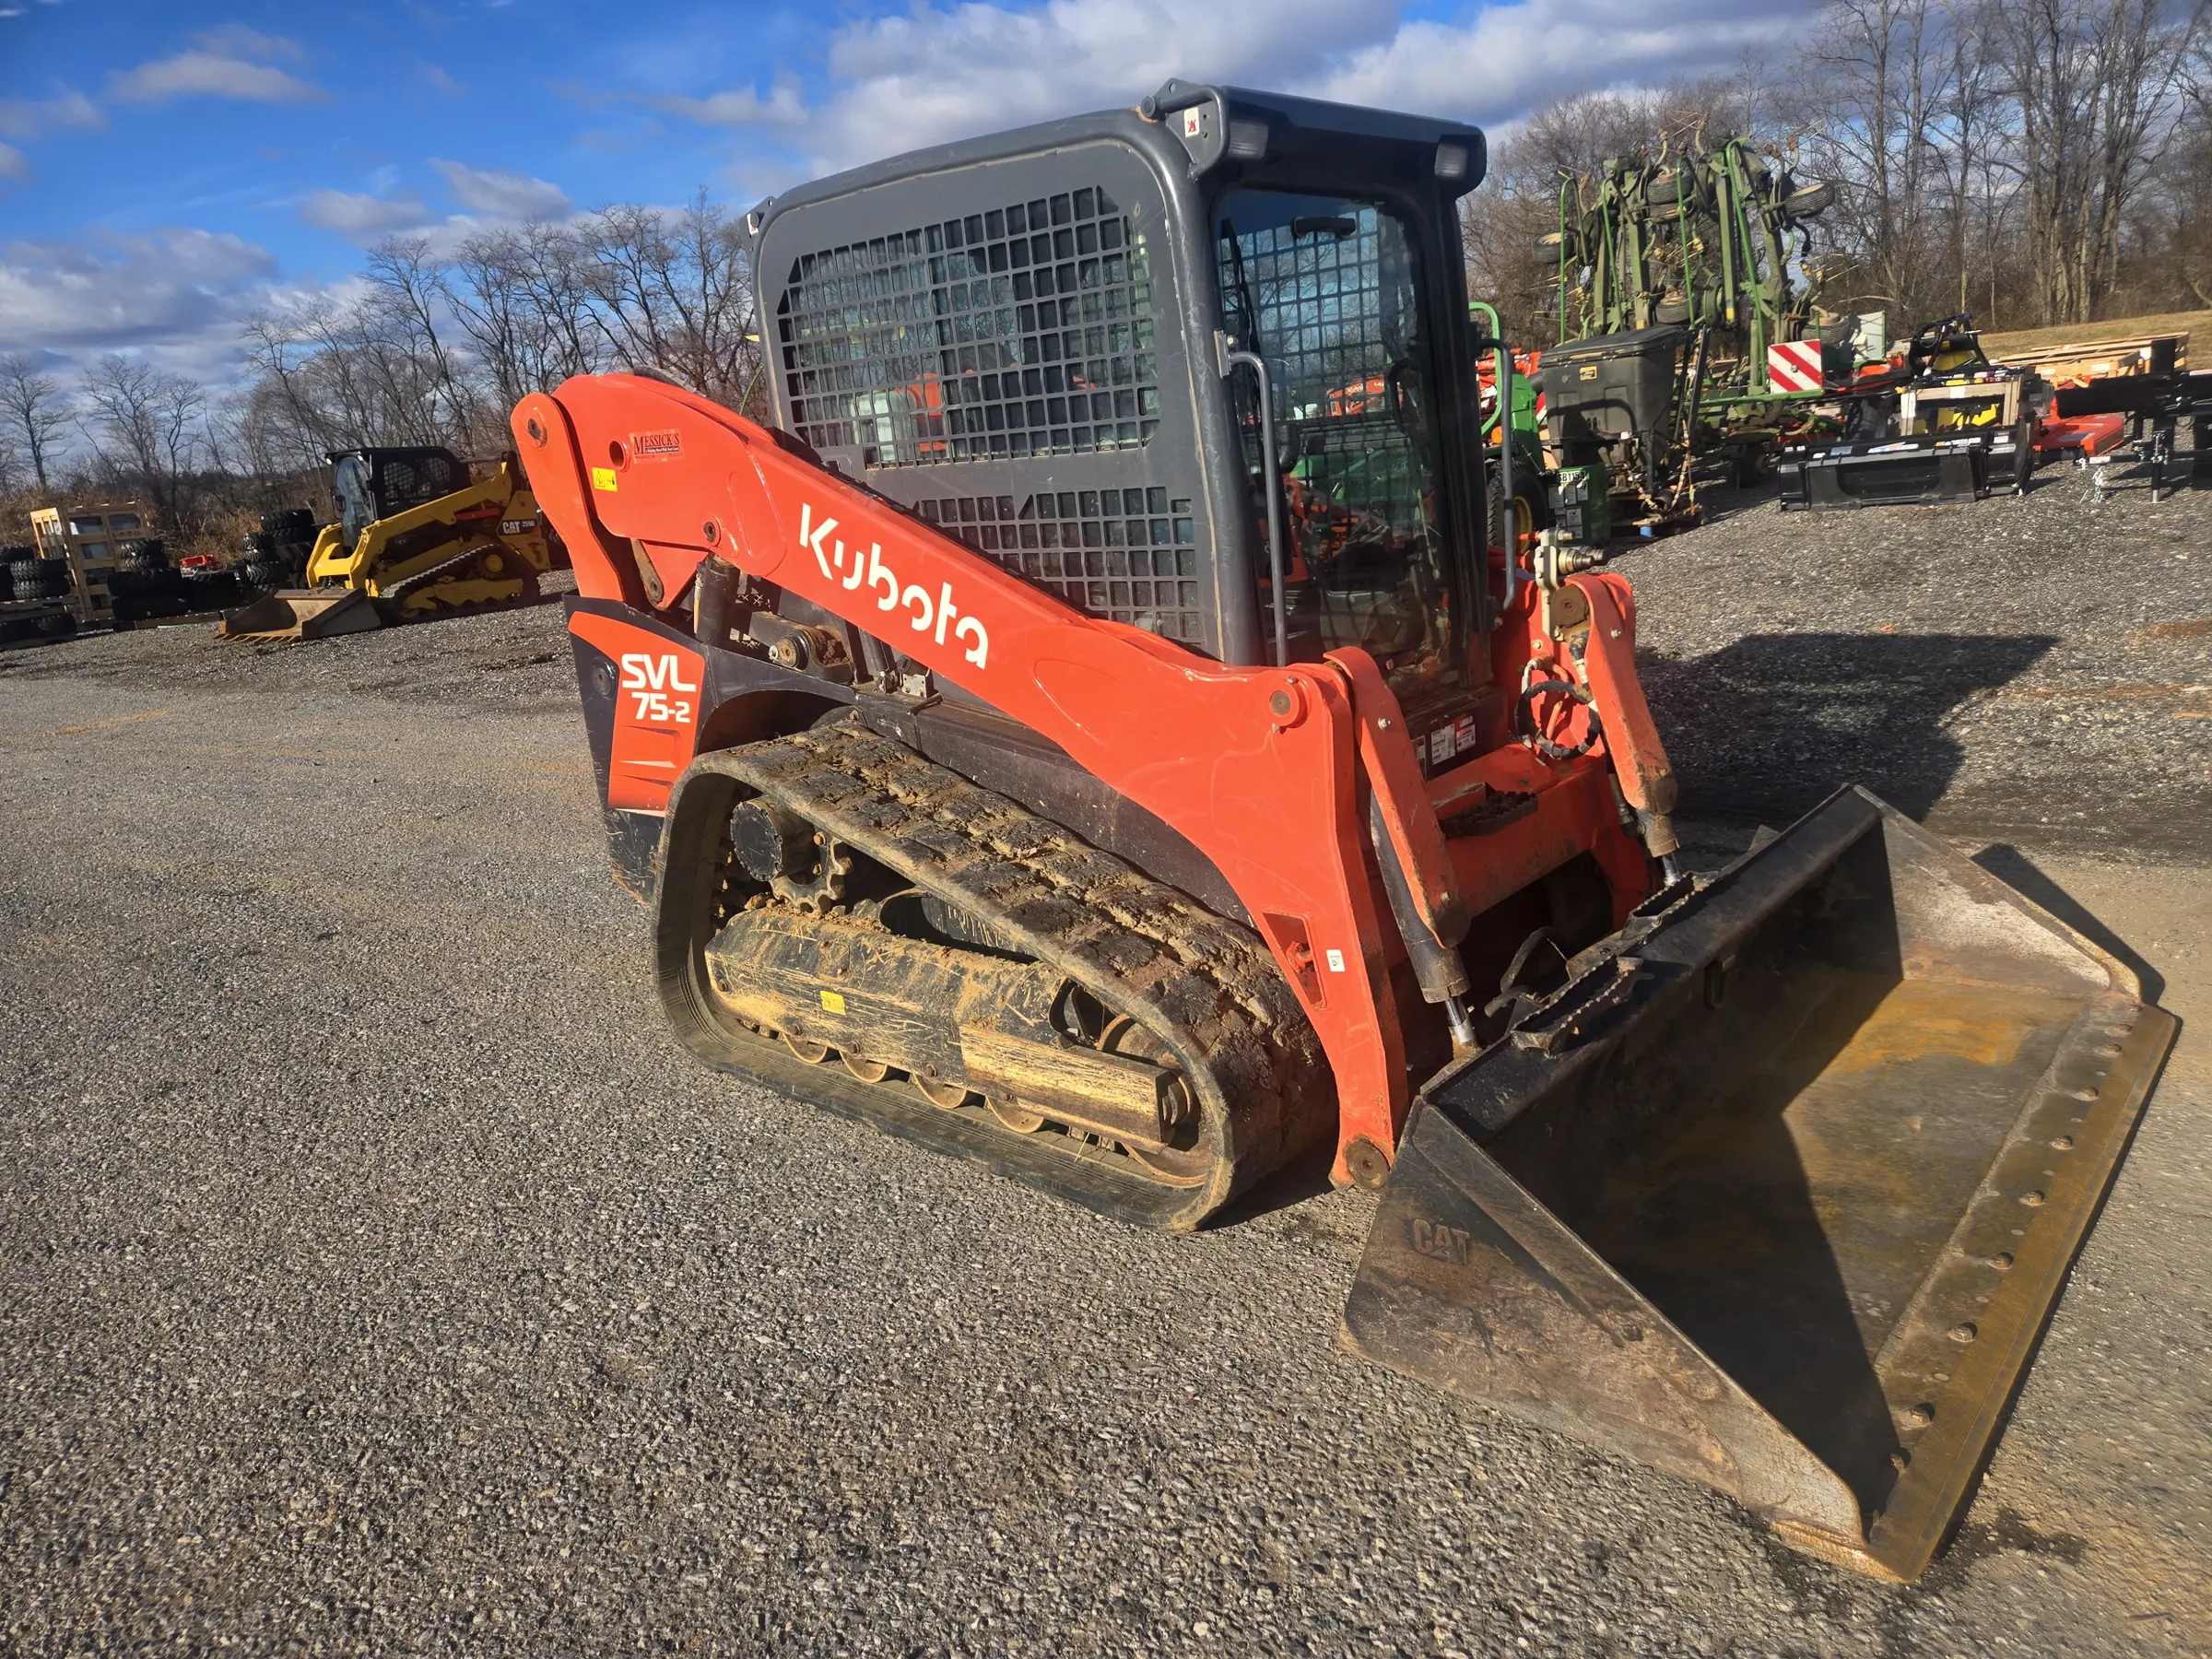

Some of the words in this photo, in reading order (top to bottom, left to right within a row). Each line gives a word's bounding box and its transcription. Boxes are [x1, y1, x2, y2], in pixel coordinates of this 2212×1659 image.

[633, 433, 679, 454] MESSICK'S
[502, 522, 520, 534] CAT
[798, 502, 989, 670] Kubota
[621, 653, 696, 691] SVL
[631, 691, 690, 724] 75-2
[1413, 1218, 1470, 1265] CAT
